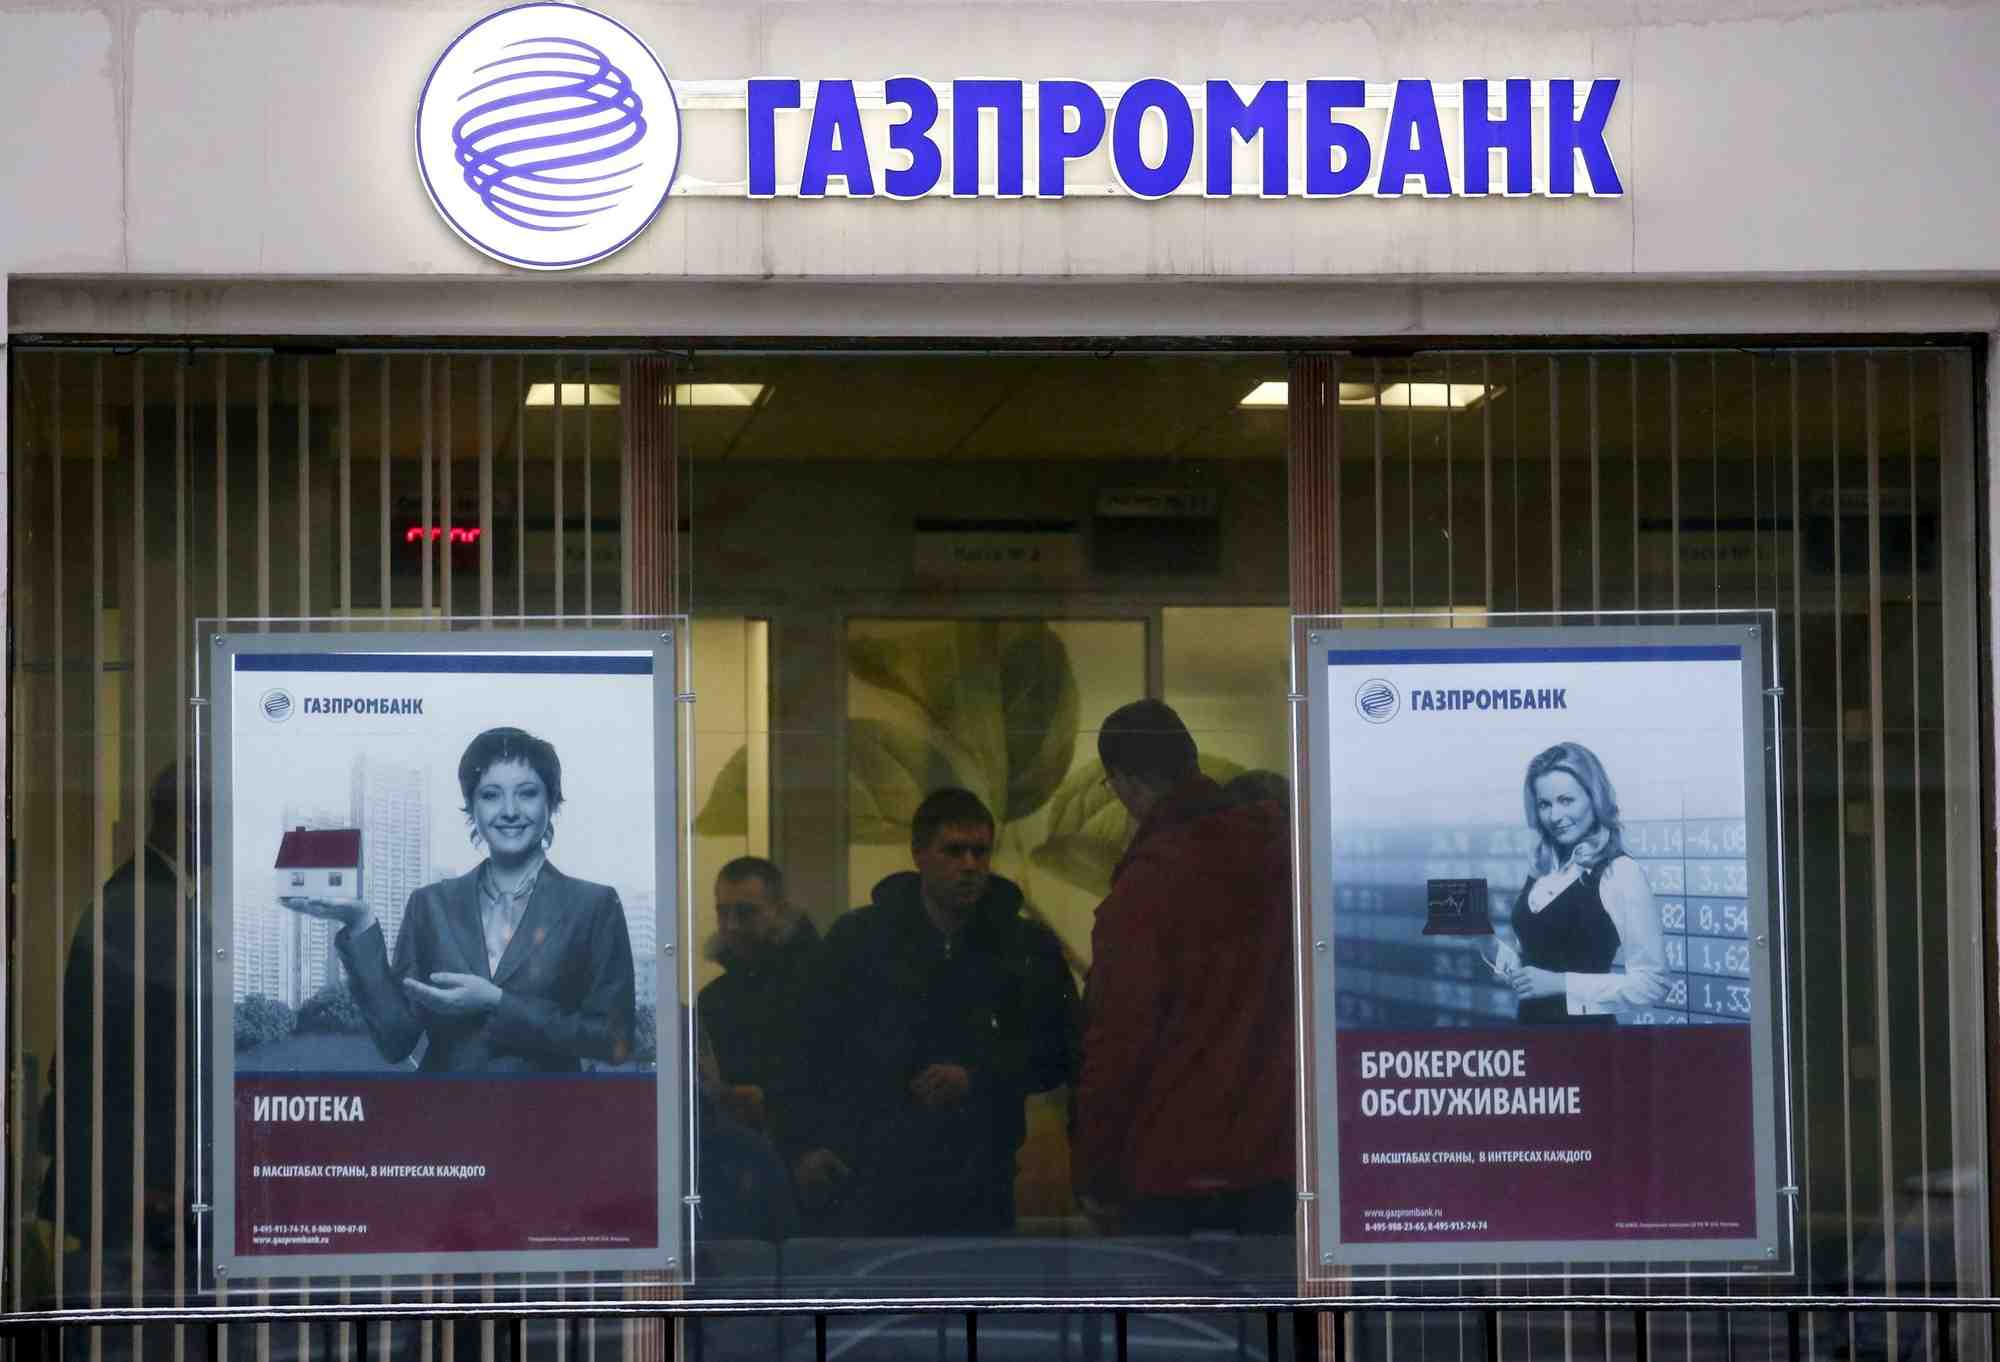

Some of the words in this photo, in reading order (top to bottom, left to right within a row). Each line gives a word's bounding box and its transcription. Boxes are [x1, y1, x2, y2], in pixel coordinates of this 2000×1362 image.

[748, 77, 1623, 197] ГАЗПРОМБАНК
[304, 697, 423, 715] ГАЗПРОМБАНК
[1411, 688, 1568, 711] ГАЗПРОМБАНК
[1699, 905, 1748, 934] 0,54
[1361, 1049, 1526, 1079] БРОКЕРСКОЕ
[253, 1096, 365, 1122] ИПОТЕКА
[1361, 1086, 1581, 1117] ОБСЛУЖИВАНИЕ
[1371, 1152, 1430, 1164] МАСШТАБАХ
[1432, 1152, 1475, 1165] СТРАНЫ,
[1488, 1151, 1542, 1163] ИНТЕРЕСАХ
[1544, 1150, 1592, 1164] КАЖДОГО
[253, 1165, 260, 1177] В
[262, 1165, 323, 1177] МАСШТАБАХ
[325, 1165, 369, 1179] СТРАНЫ,
[371, 1165, 378, 1177] В
[380, 1165, 435, 1177] ИНТЕРЕСАХ
[437, 1165, 486, 1179] КАЖДОГО
